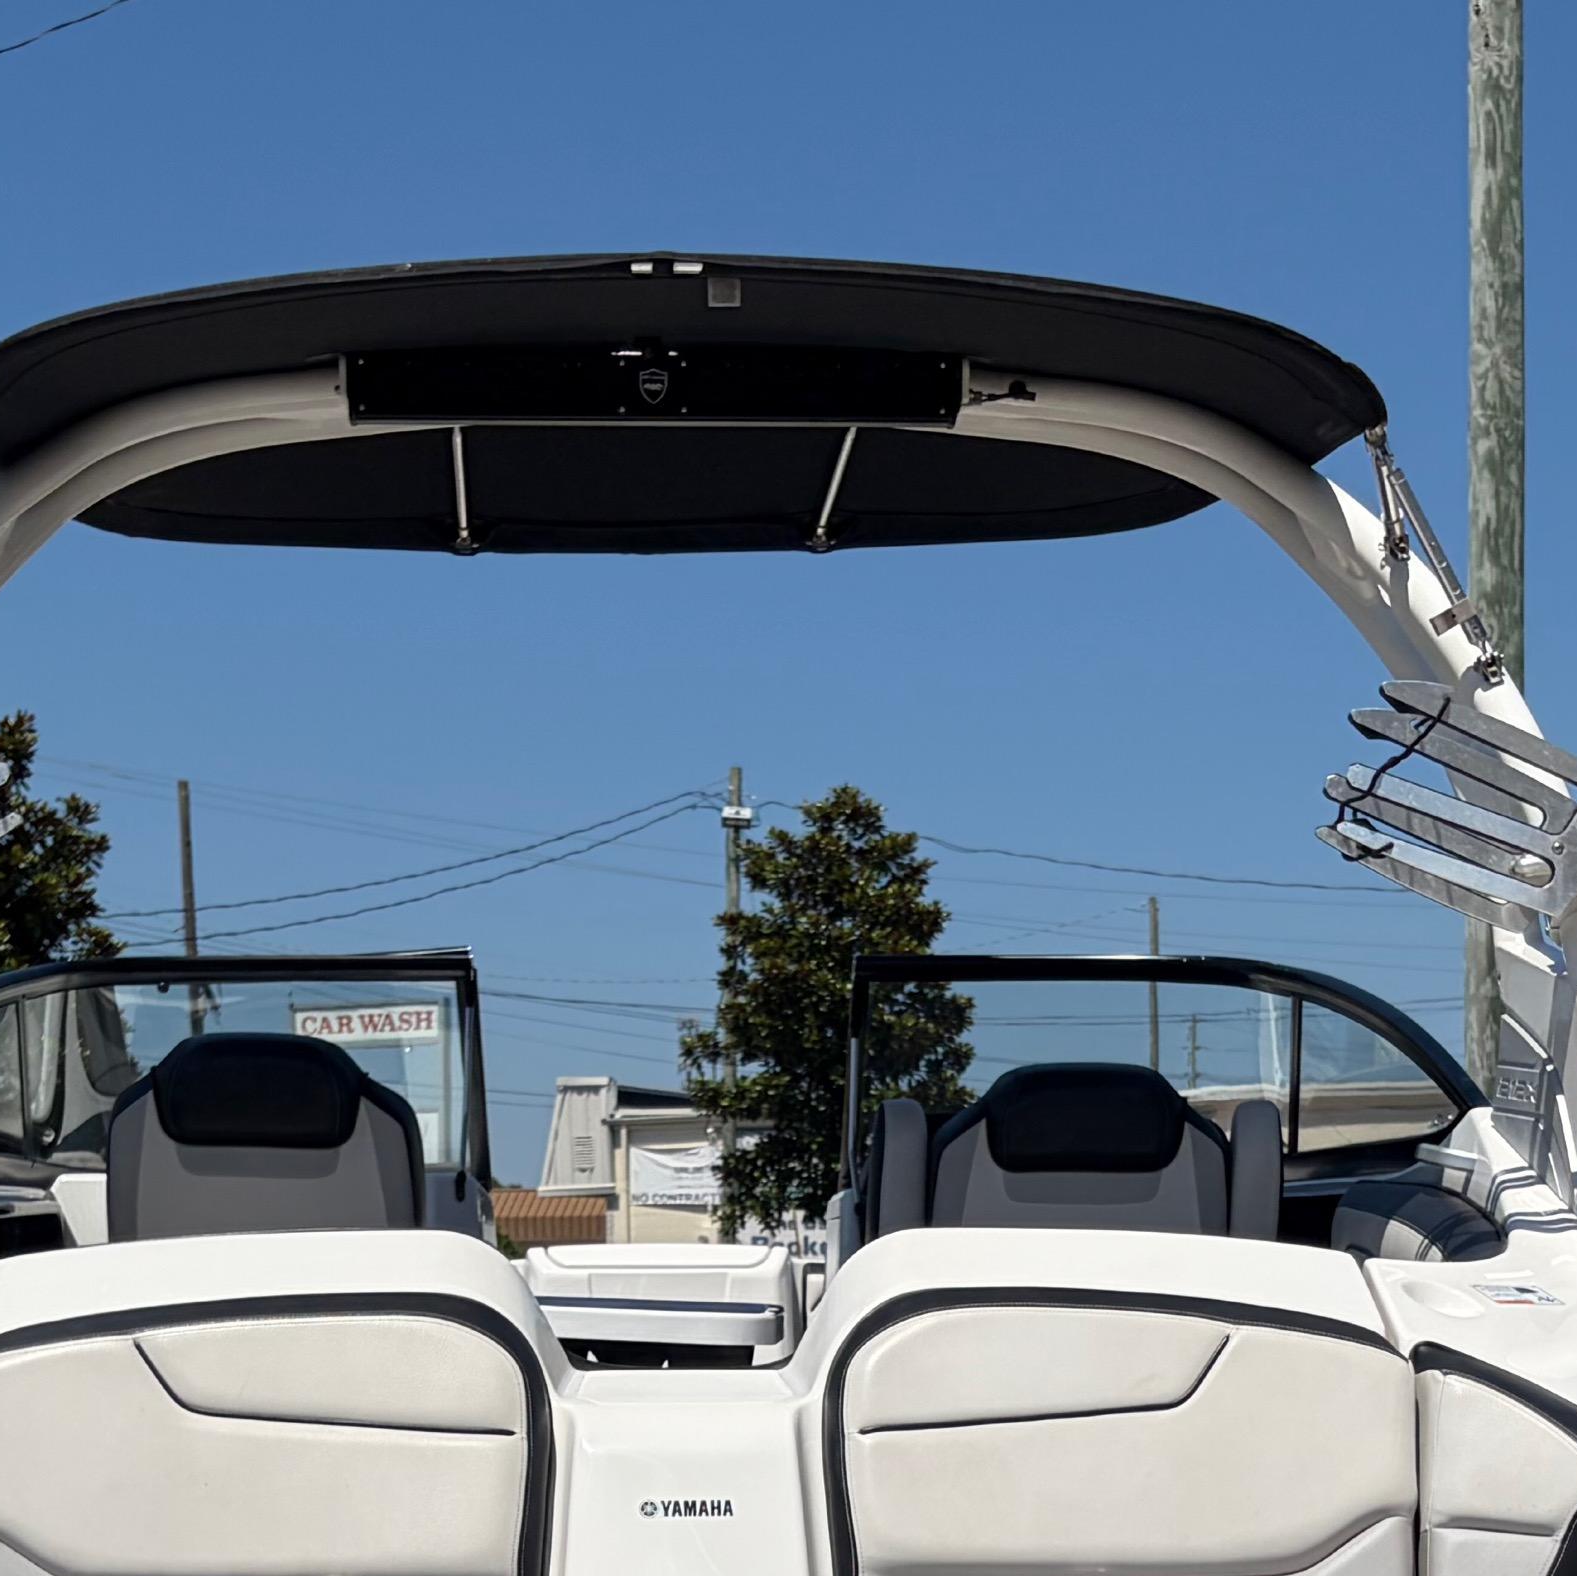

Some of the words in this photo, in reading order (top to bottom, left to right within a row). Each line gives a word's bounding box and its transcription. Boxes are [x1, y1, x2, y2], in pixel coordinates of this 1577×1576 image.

[301, 1014, 355, 1036] CAR
[358, 1010, 435, 1034] WASH
[660, 1499, 734, 1518] YAMAHA
